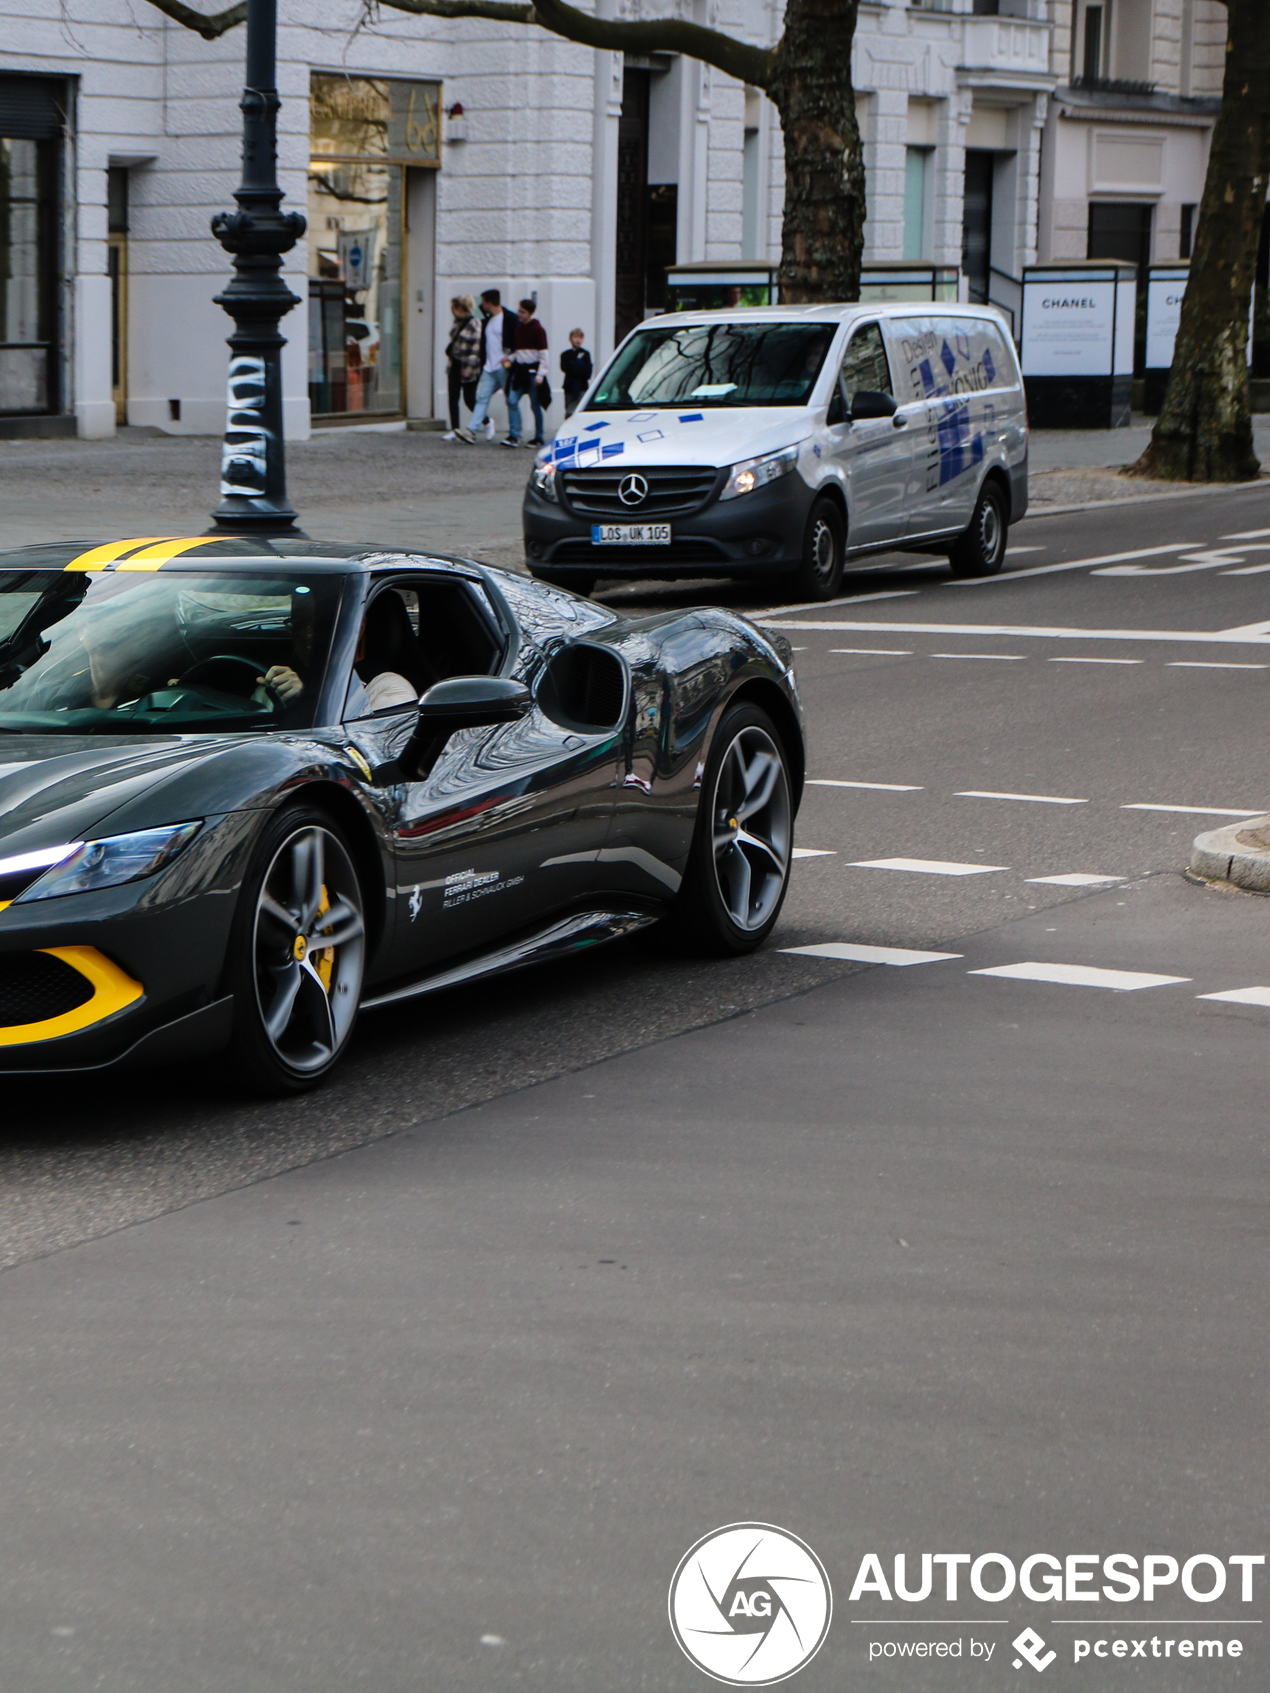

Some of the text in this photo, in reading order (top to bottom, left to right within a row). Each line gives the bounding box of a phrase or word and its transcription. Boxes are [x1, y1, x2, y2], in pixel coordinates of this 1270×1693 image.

[1041, 297, 1097, 309] CHANEL
[600, 526, 669, 540] LOS UK 105
[444, 872, 500, 897] FERRARI DEALER
[445, 868, 476, 885] OFFICIAL
[442, 894, 465, 909] RILLER
[471, 880, 506, 900] SCHNAUCK
